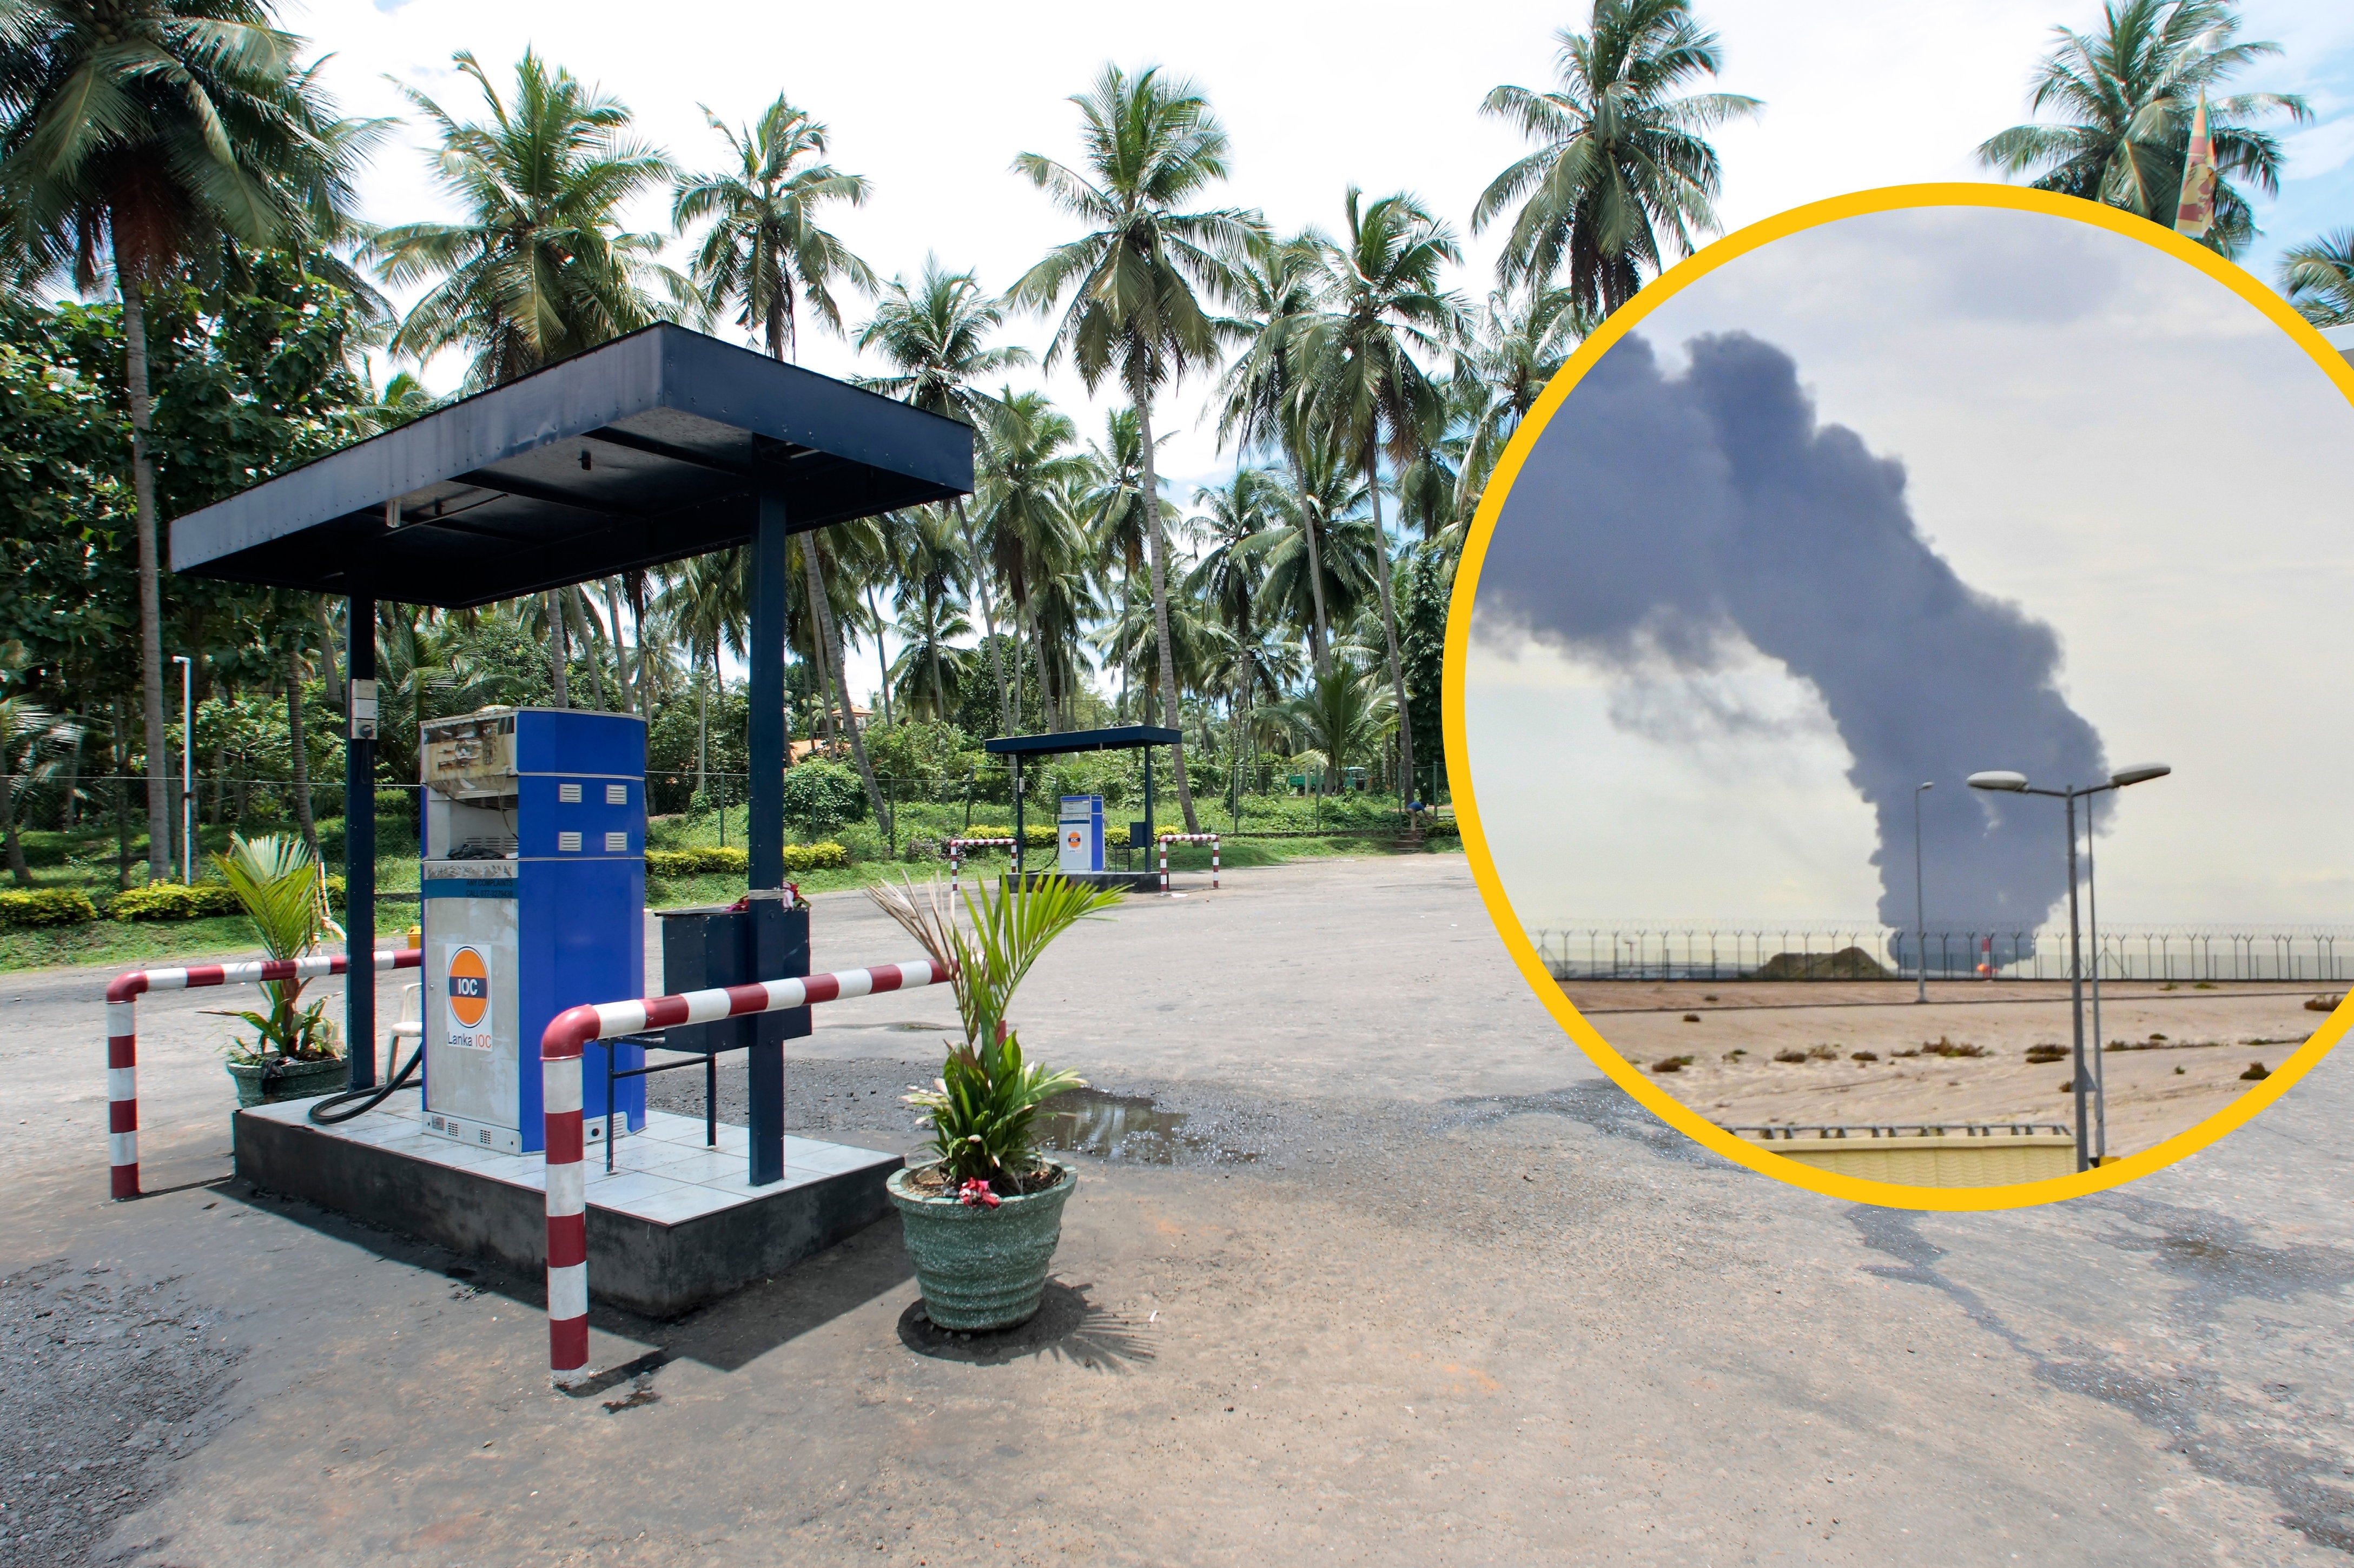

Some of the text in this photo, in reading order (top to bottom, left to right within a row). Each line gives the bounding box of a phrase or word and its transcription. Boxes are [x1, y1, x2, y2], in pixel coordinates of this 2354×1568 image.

[478, 879, 513, 887] COMPLAINTS
[458, 978, 478, 996] IOC
[447, 1031, 492, 1048] Lanka IOC
